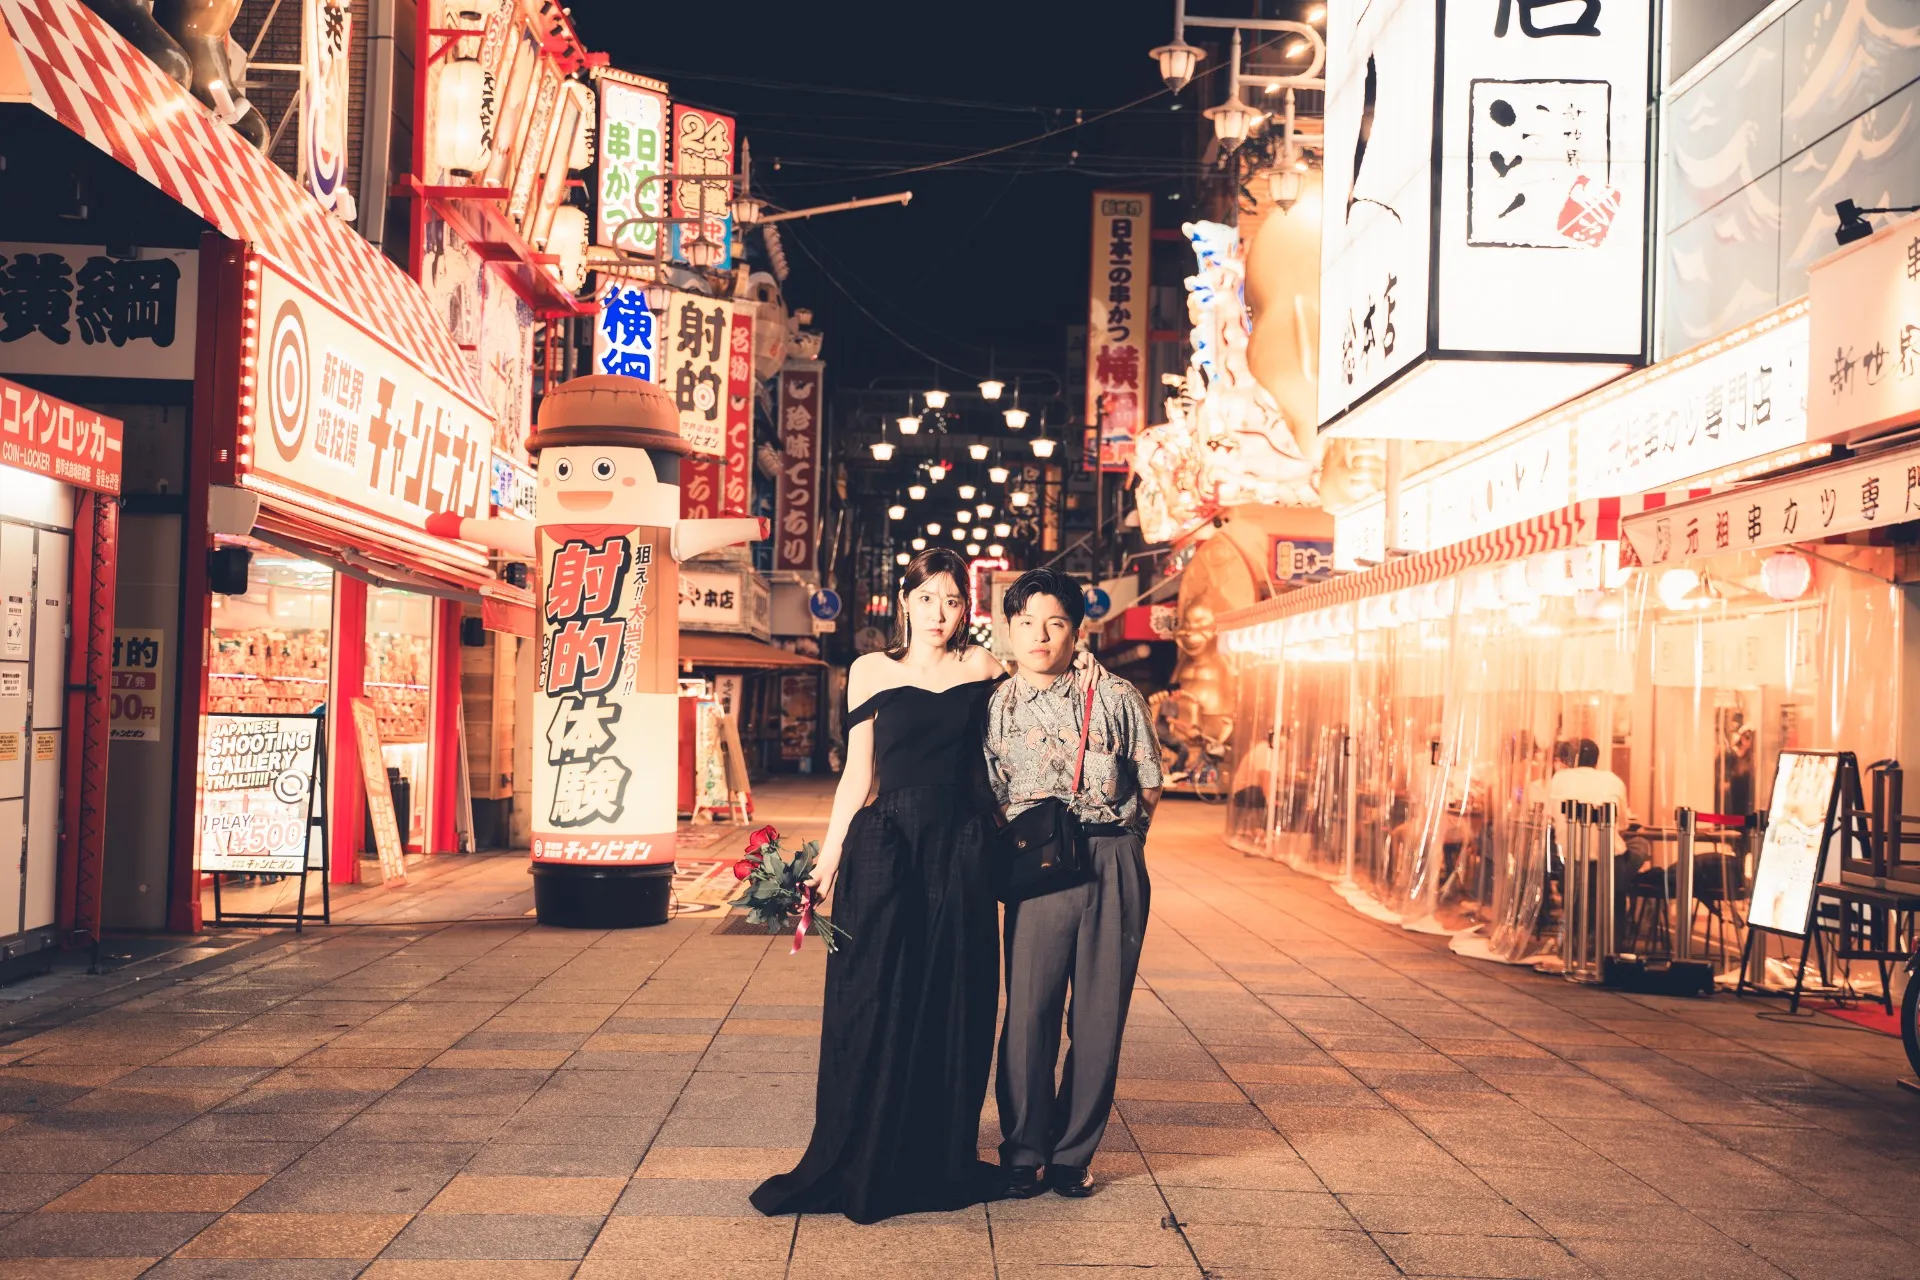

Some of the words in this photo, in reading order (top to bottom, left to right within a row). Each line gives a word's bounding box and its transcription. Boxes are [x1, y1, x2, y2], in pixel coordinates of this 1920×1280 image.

[1107, 219, 1132, 342] 日本一の串かつ
[321, 351, 365, 415] 新世界
[676, 300, 726, 421] 射的
[730, 326, 750, 382] 名物
[2, 440, 51, 472] COIN-LOCKER
[3, 386, 121, 463] コインロッカー
[368, 376, 484, 519] チャンピオン
[726, 422, 748, 513] てっち
[783, 404, 812, 565] 珍味てっちり
[546, 536, 632, 828] 射的体験
[206, 750, 298, 777] GALLERY
[208, 730, 311, 757] SHOOTING
[212, 720, 279, 738] JAPANESE
[563, 840, 652, 861] チャンピオン
